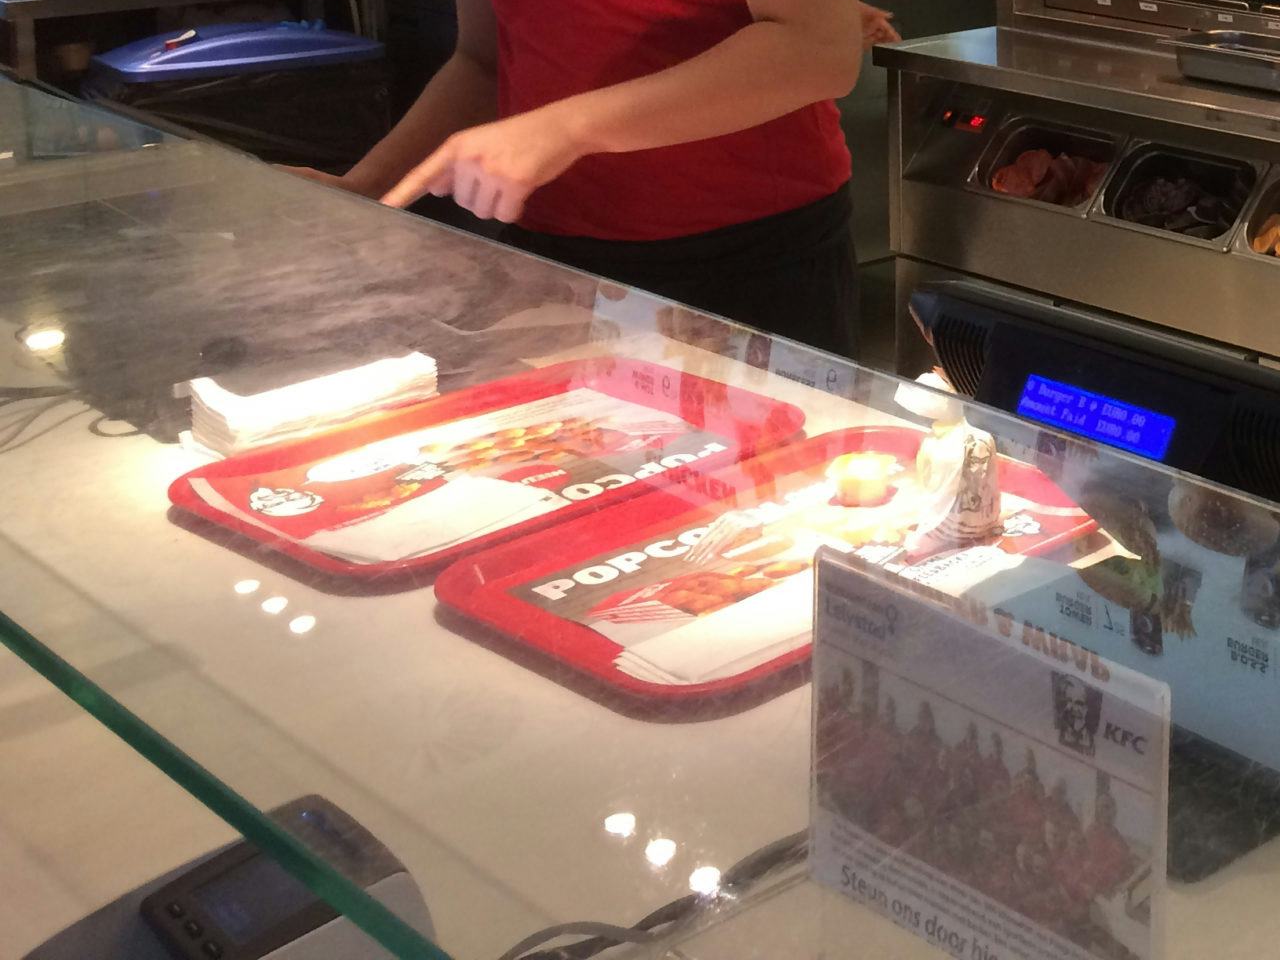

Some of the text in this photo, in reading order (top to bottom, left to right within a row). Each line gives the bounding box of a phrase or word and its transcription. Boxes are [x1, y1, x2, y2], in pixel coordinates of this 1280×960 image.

[531, 526, 712, 601] POPCO
[1104, 721, 1147, 756] KFC
[838, 864, 889, 907] Steun
[891, 895, 922, 929] ons
[924, 914, 966, 956] door
